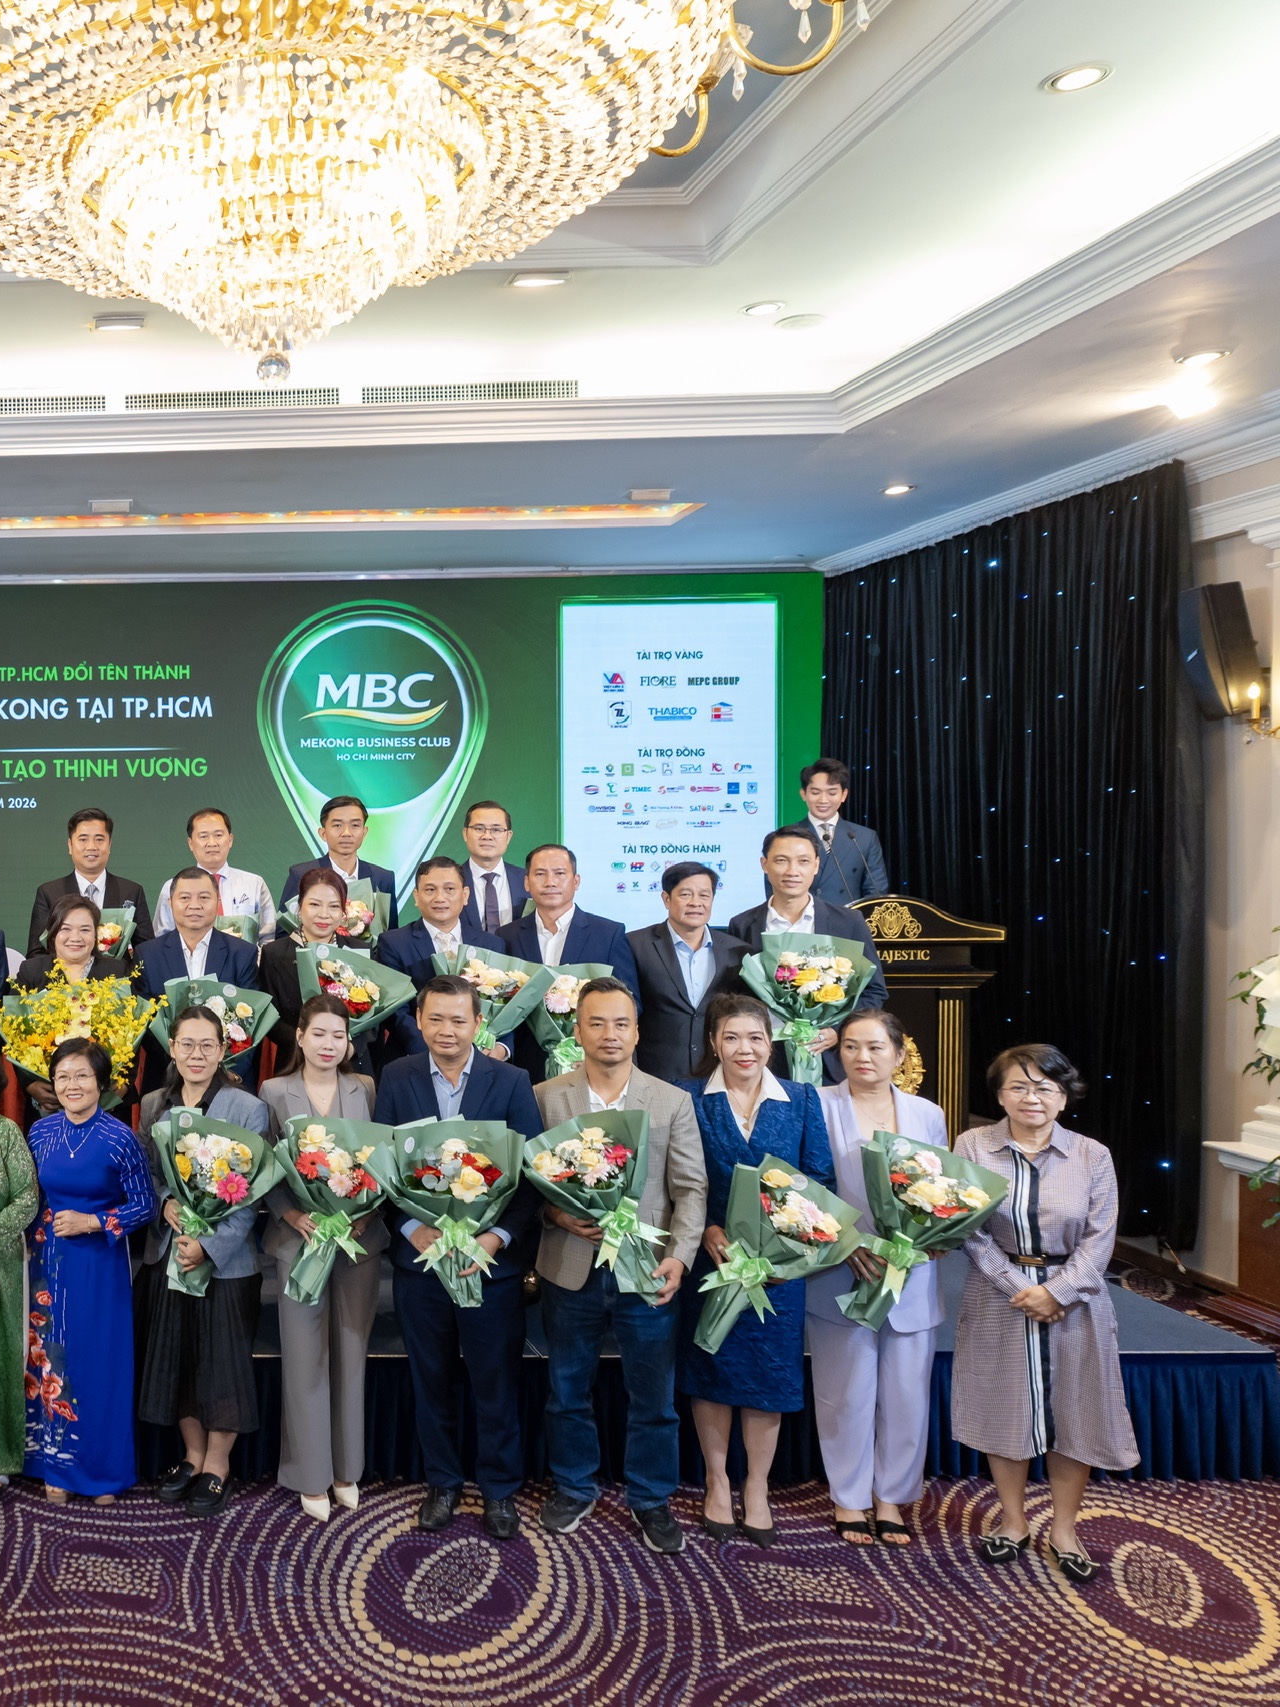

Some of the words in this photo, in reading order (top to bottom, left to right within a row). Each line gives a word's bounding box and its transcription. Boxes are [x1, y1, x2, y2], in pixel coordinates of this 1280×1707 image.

[637, 650, 650, 660] TÀI
[654, 651, 672, 661] TRỢ
[675, 649, 703, 659] VÀNG
[0, 666, 58, 682] TP.HCM
[63, 661, 92, 681] ĐỔI
[98, 663, 128, 680] TÊN
[134, 662, 190, 680] THÀNH
[640, 676, 676, 686] FIORE
[688, 677, 710, 686] MEPC
[713, 677, 740, 685] GROUP
[316, 673, 434, 708] MBC
[77, 698, 113, 723] TẠI
[122, 696, 212, 718] TP.HCM
[648, 707, 697, 715] THABICO
[300, 738, 354, 748] MEKONG
[357, 737, 416, 747] BUSINESS
[419, 737, 451, 746] CLUB
[638, 747, 652, 758] TÀI
[655, 749, 673, 759] TRỢ
[676, 746, 705, 757] ĐỒNG
[2, 760, 46, 782] TẠO
[53, 760, 117, 782] THỊNH
[125, 757, 208, 781] VƯỢNG
[8, 798, 36, 808] 2026
[623, 843, 636, 853] TÀI
[640, 845, 658, 855] TRỢ
[661, 843, 690, 853] ĐỒNG
[693, 843, 720, 853] HÀNH
